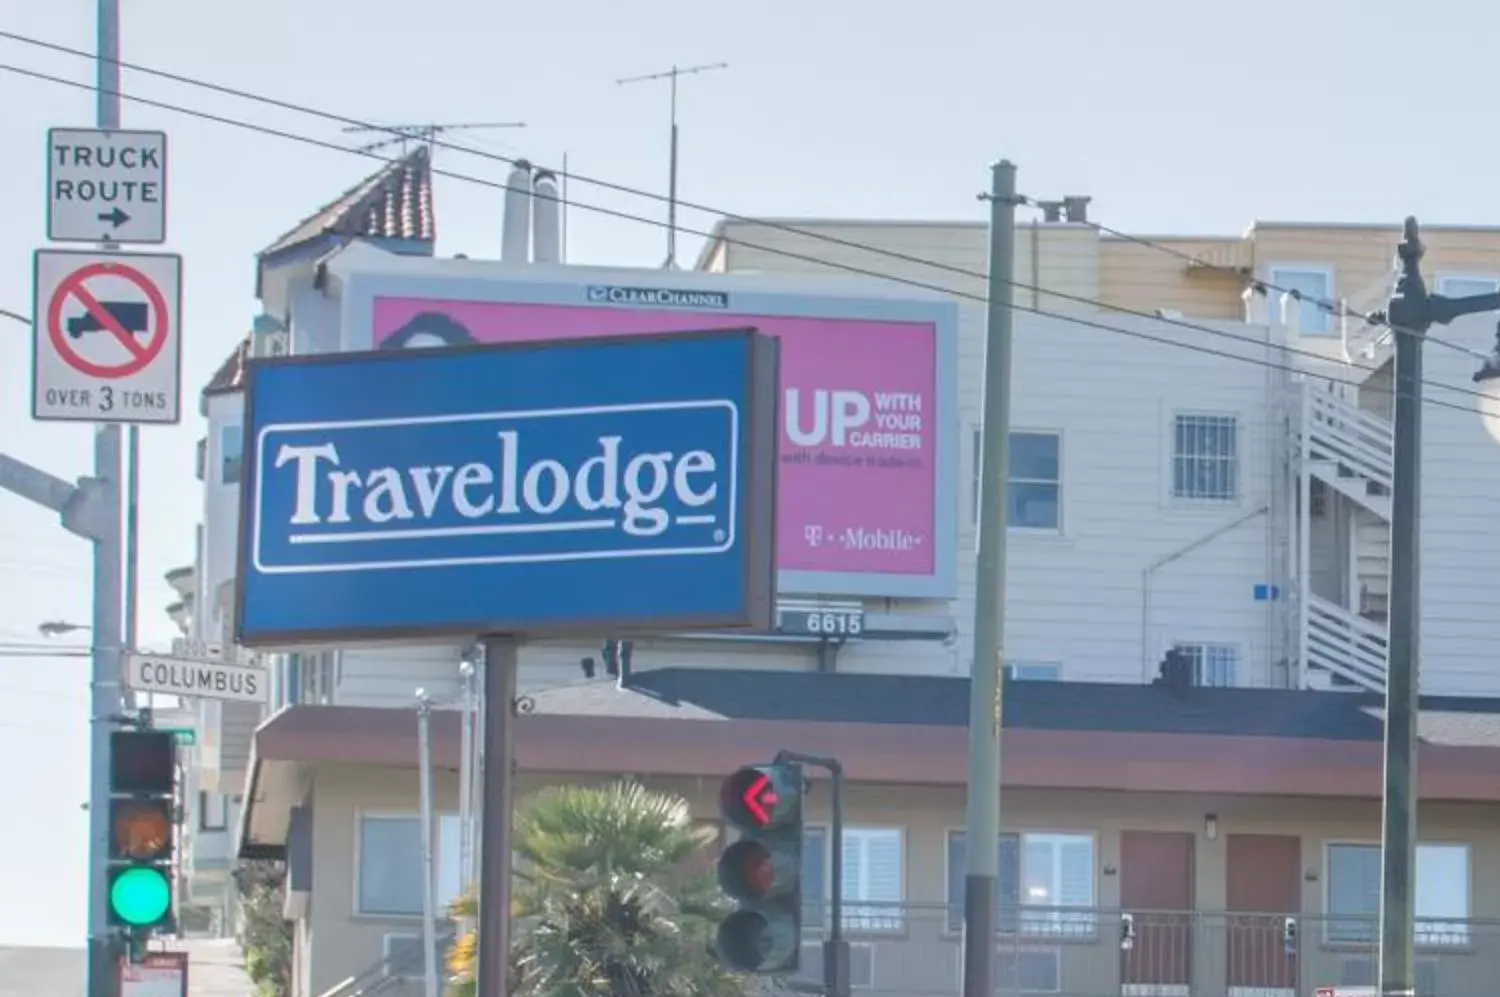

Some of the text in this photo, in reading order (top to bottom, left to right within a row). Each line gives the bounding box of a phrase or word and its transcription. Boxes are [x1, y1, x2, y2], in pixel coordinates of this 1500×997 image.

[55, 146, 159, 168] TRUCK
[56, 179, 158, 202] ROUTE
[46, 385, 166, 411] OVER 3 TONS
[875, 392, 922, 411] WITH
[785, 387, 871, 447] UP
[876, 413, 922, 430] YOUR
[850, 431, 922, 449] CARRIER
[275, 431, 718, 537] Travelodge
[807, 613, 862, 633] 6615
[141, 662, 257, 695] COLUMBUS
